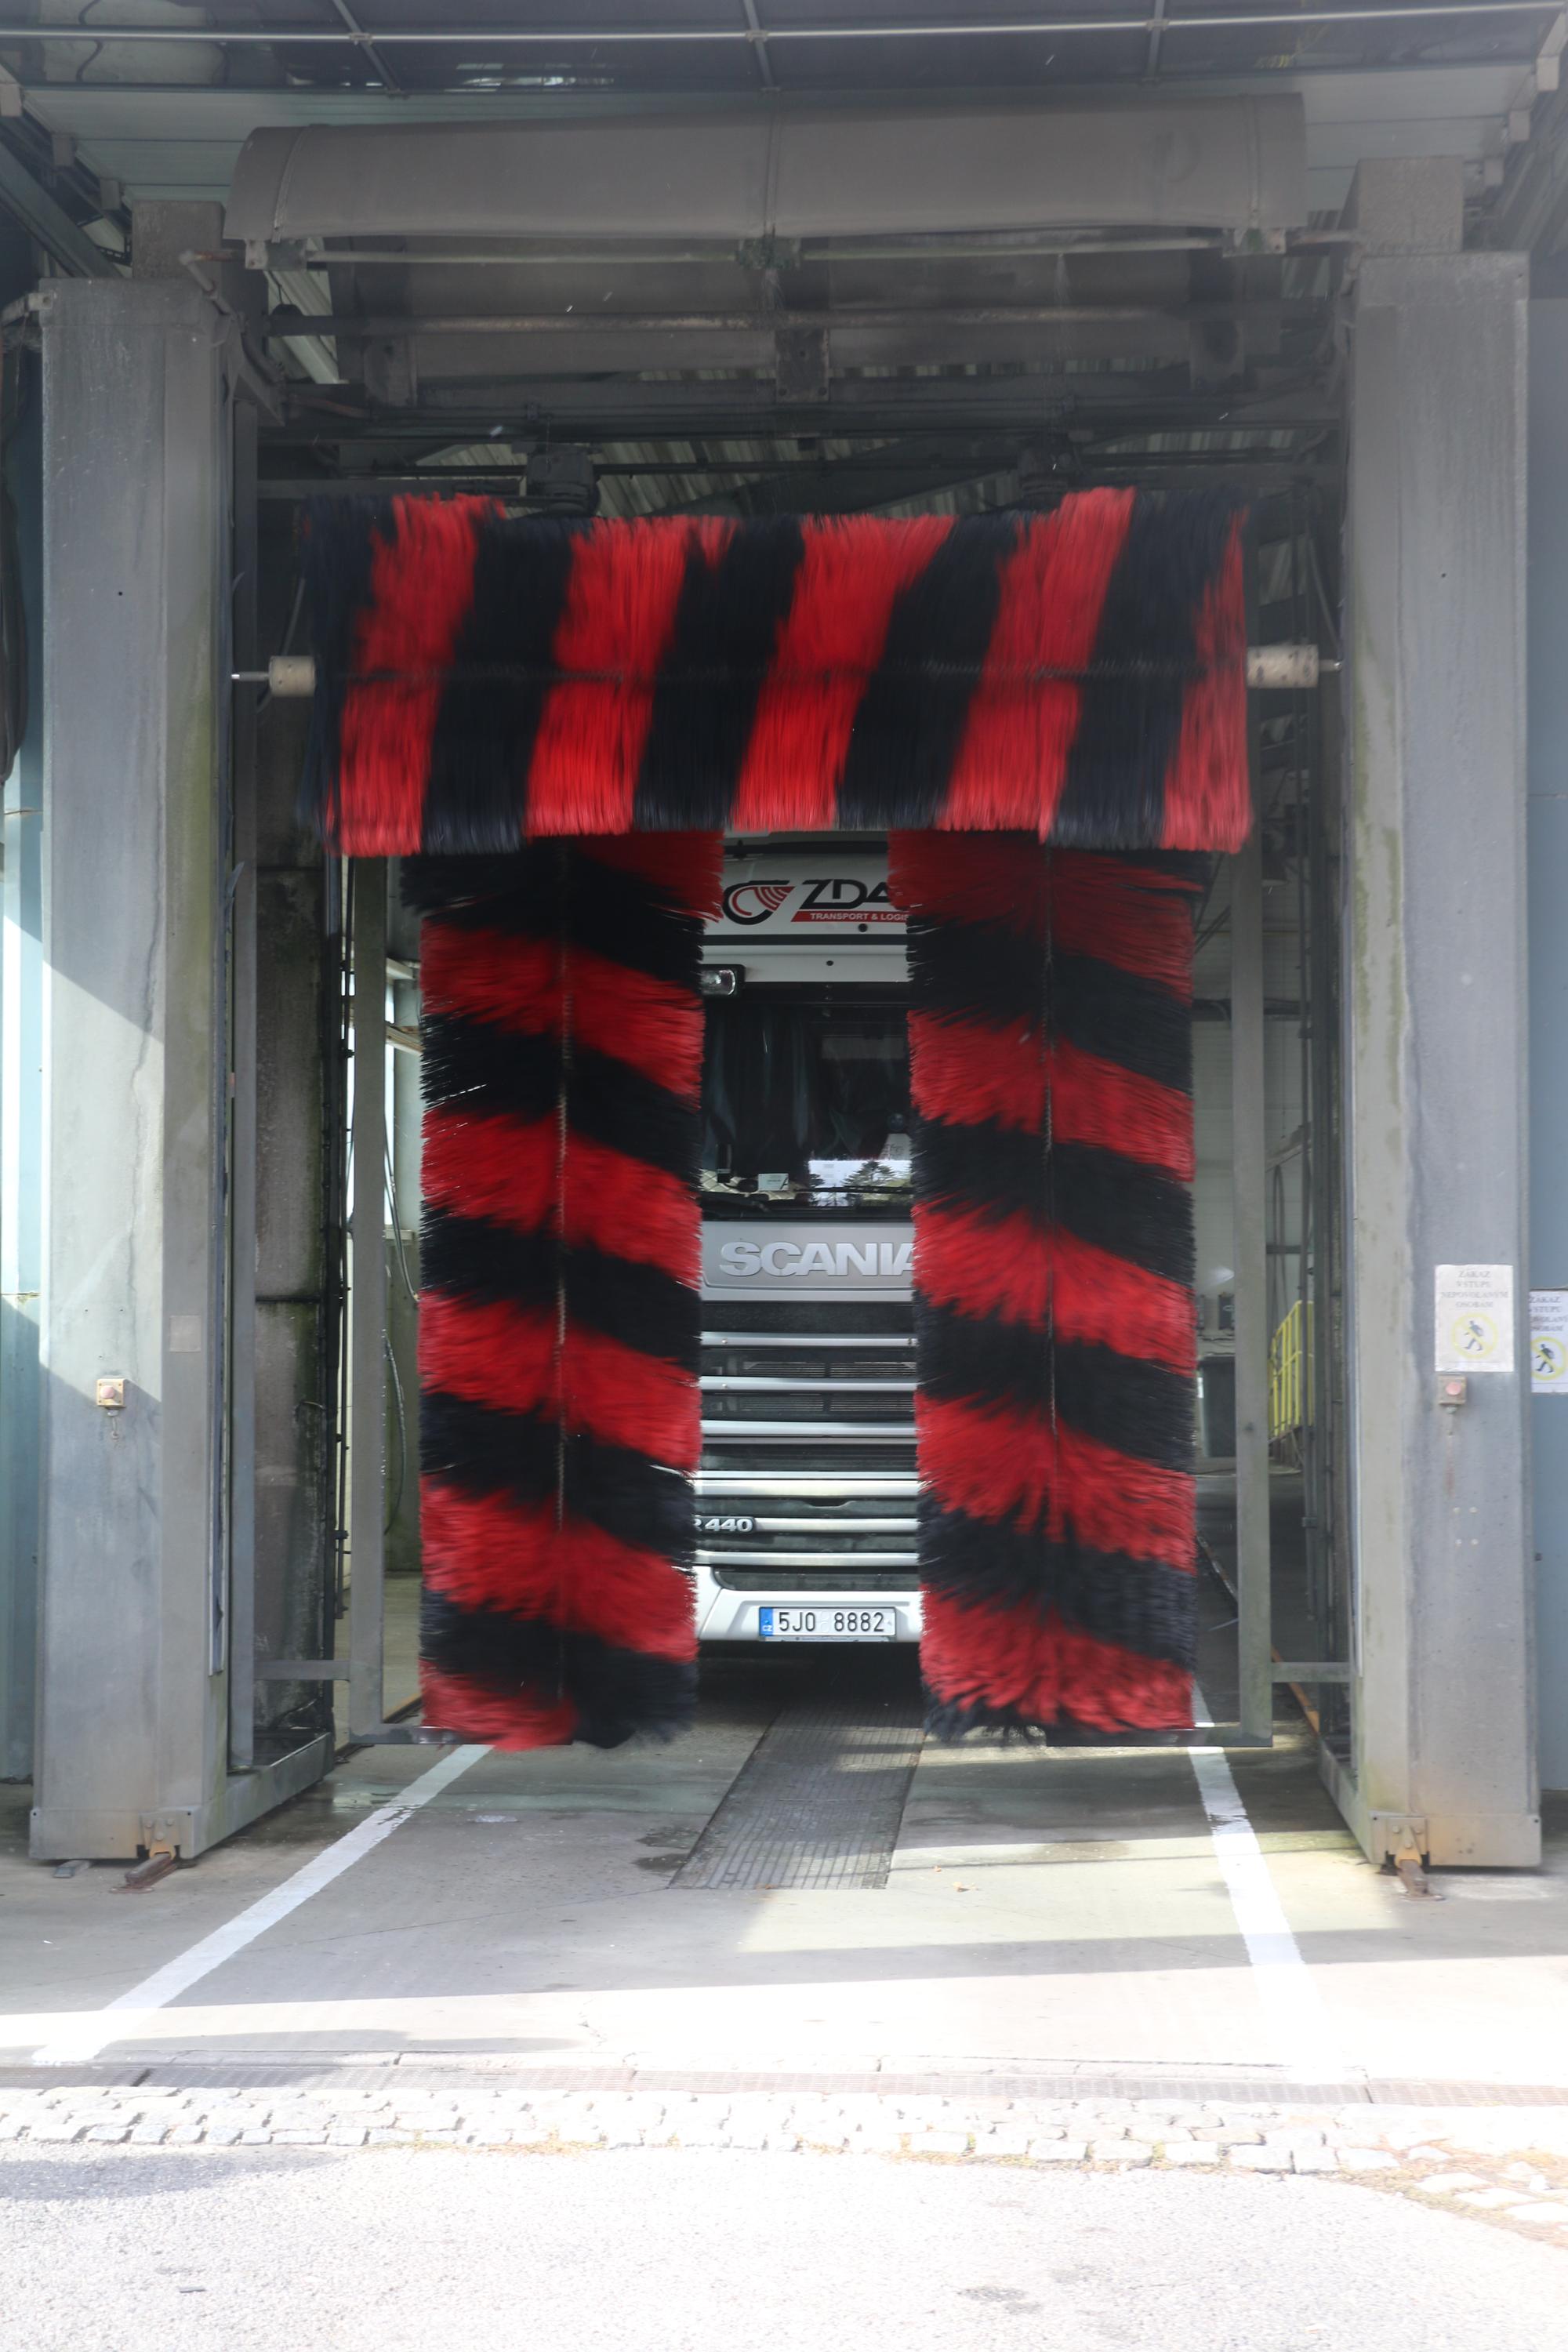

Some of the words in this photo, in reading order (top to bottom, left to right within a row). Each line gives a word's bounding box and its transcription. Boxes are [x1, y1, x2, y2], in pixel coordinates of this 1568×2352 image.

[810, 912, 869, 920] TRANSPORT
[704, 1518, 753, 1533] 440
[834, 1612, 884, 1632] 8882
